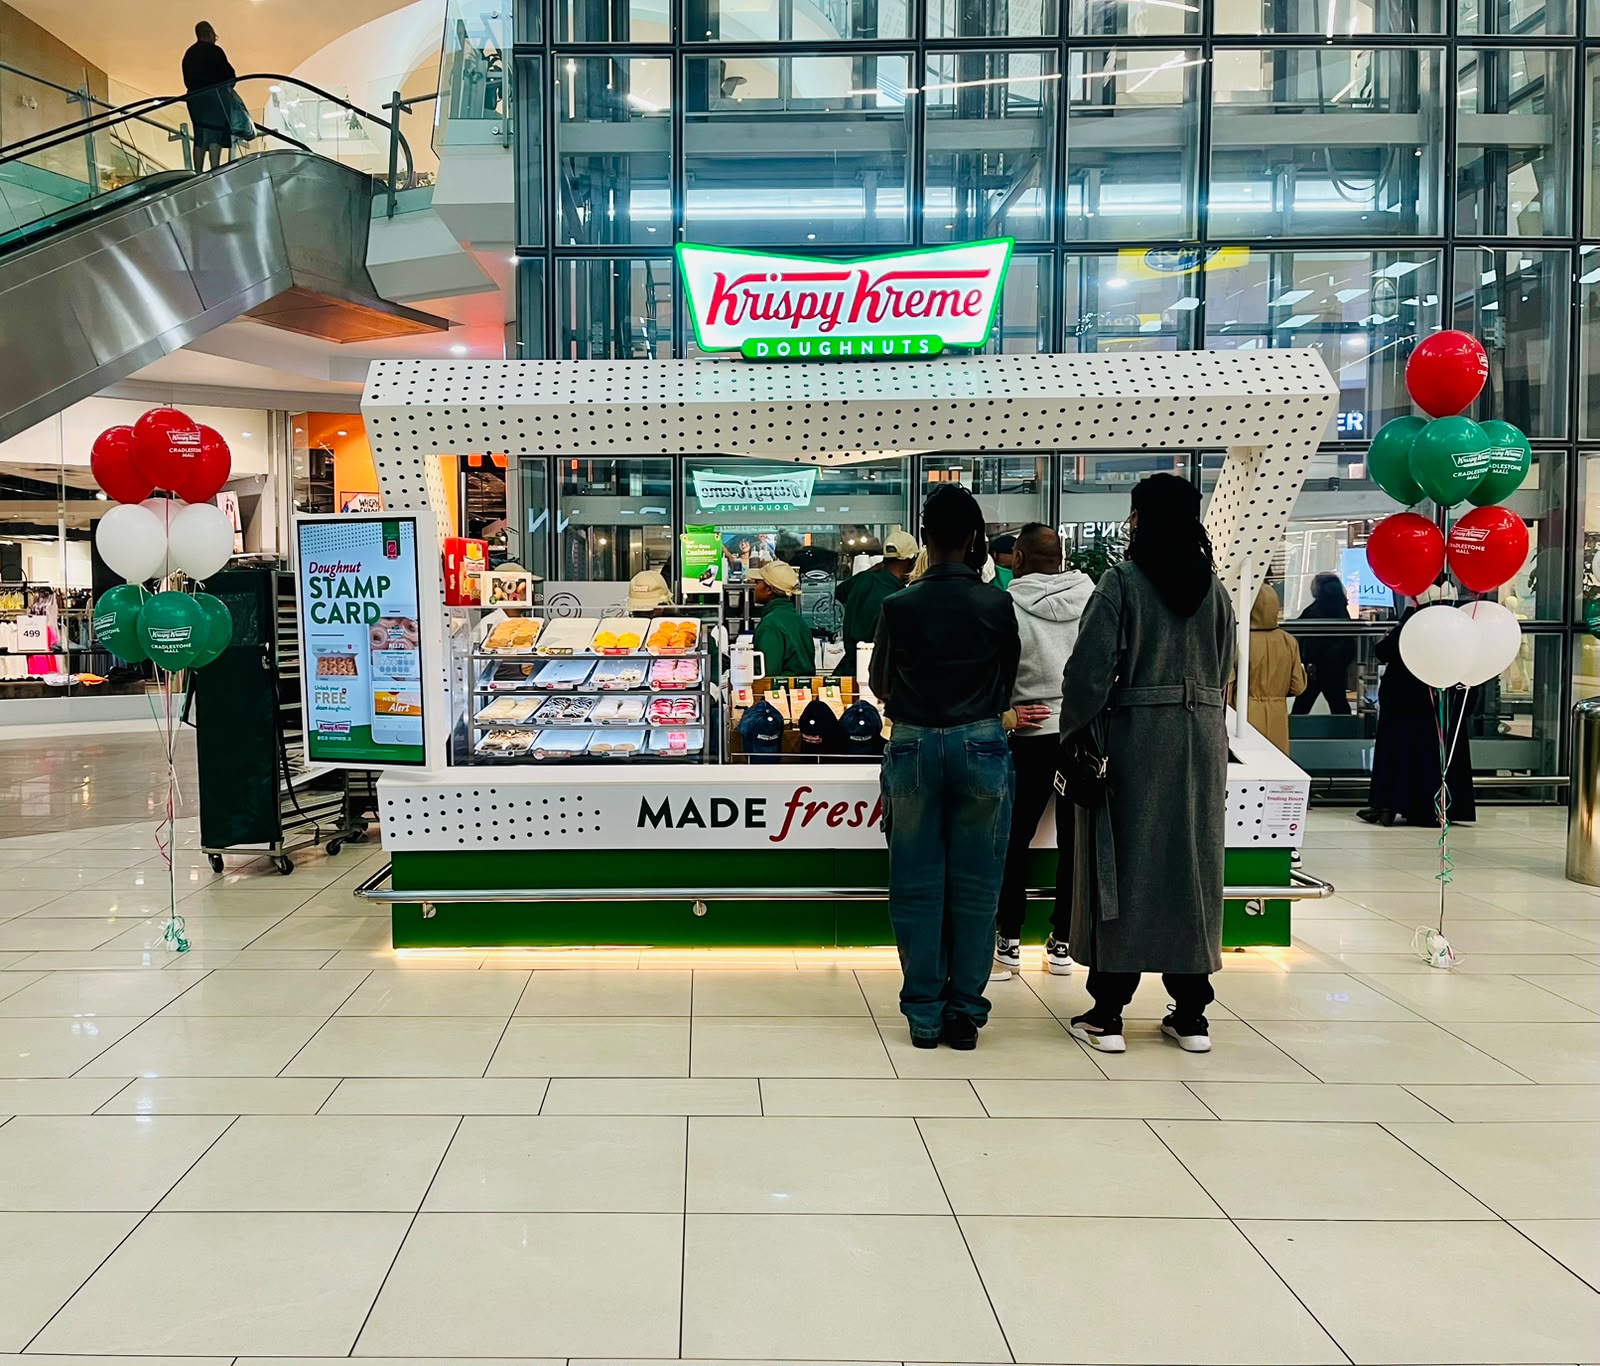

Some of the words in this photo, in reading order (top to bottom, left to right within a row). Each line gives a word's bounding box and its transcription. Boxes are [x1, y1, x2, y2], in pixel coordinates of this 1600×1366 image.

[706, 270, 852, 333] Krispy
[848, 268, 991, 324] Kreme
[756, 338, 930, 357] DOUGHNUTS
[309, 560, 362, 578] Doughnut
[309, 575, 391, 599] STAMP
[310, 602, 381, 625] CARD
[23, 629, 41, 638] 499
[151, 642, 192, 650] CRADLESTONE
[314, 691, 347, 704] FREE
[388, 702, 411, 713] Alert
[637, 795, 767, 830] MADE
